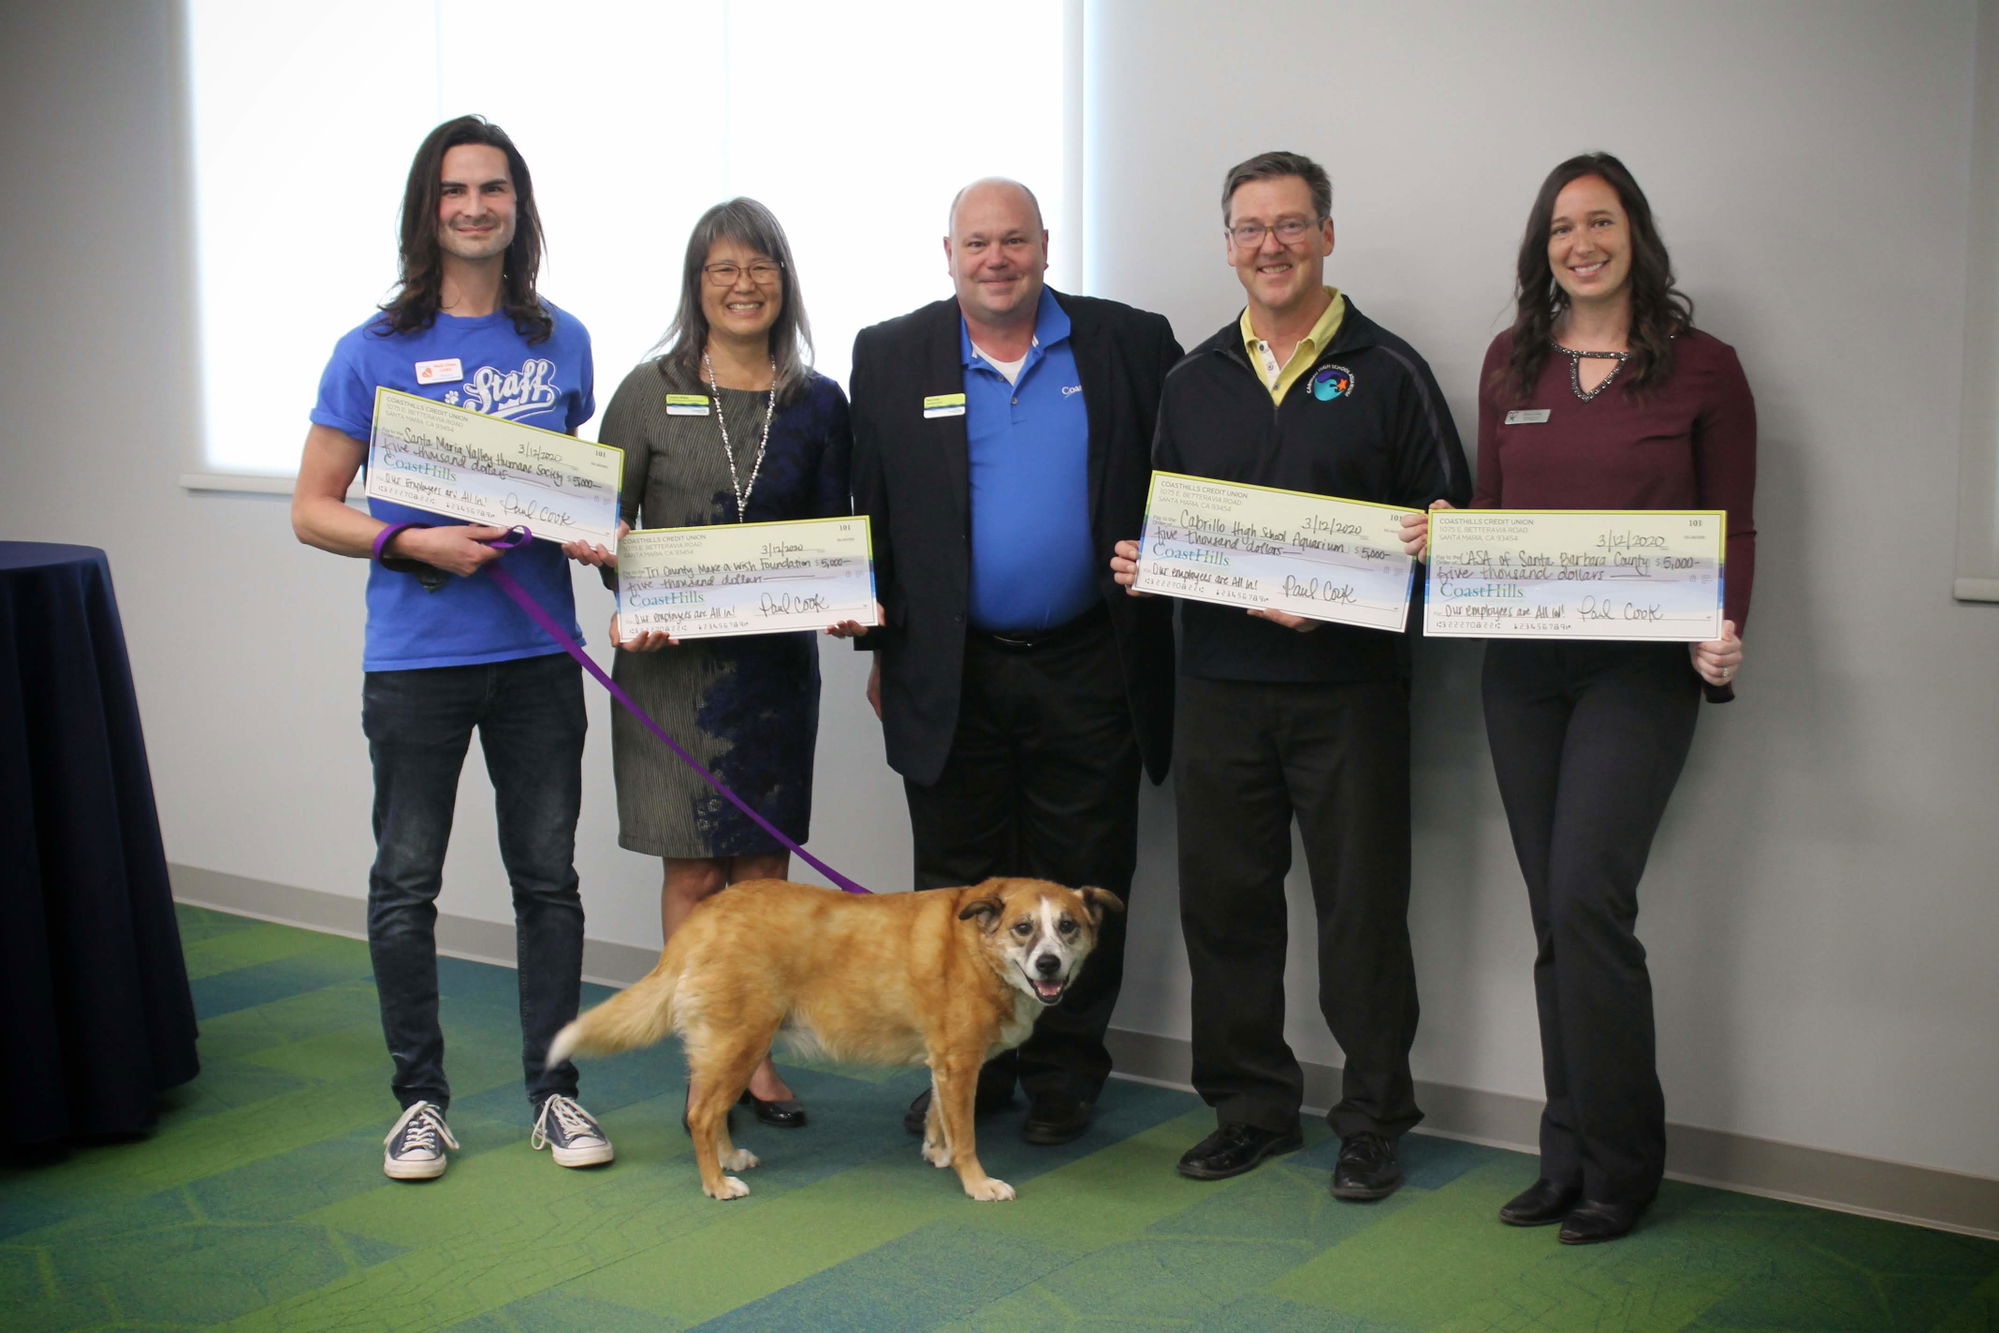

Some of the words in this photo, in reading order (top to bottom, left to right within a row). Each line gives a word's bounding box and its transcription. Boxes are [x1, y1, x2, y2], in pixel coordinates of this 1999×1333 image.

[463, 358, 557, 414] Staff
[403, 426, 432, 447] Santa
[436, 435, 463, 454] Maria
[464, 443, 495, 467] Valley
[497, 453, 533, 474] Humane
[413, 445, 467, 469] thousand
[518, 441, 562, 462] 3/12/2020
[383, 453, 457, 482] CoastHills
[385, 472, 400, 485] Our
[1160, 480, 1201, 492] COASTHILLS
[1202, 486, 1226, 496] CREDIT
[1226, 489, 1248, 499] UNION
[500, 491, 537, 520] Paul
[539, 506, 577, 527] Cook
[1180, 509, 1226, 533] Cabrillo
[1232, 520, 1257, 545] High
[1262, 526, 1287, 543] School
[1292, 532, 1344, 553] Aquarium
[1302, 515, 1362, 535] 3/12/2020
[1439, 517, 1483, 525] COASTHILLS
[1484, 518, 1511, 526] CREDIT
[1512, 518, 1534, 526] UNION
[1688, 519, 1703, 527] 101
[761, 540, 804, 557] 3/12/2020
[1153, 526, 1178, 546] five
[1186, 530, 1239, 550] thousand
[1245, 540, 1281, 556] dollars
[1596, 529, 1665, 553] 3/12/2020
[1152, 543, 1230, 567] CoastHills
[1498, 551, 1510, 567] of
[1519, 550, 1554, 567] Santa
[1559, 551, 1606, 567] Barbara
[1613, 551, 1651, 578] County
[644, 565, 659, 579] Tri
[663, 564, 694, 579] County
[697, 563, 721, 576] Make
[723, 563, 732, 573] a
[733, 560, 757, 572] Wish
[760, 557, 811, 571] Foundation
[1152, 562, 1169, 576] Our
[1171, 567, 1212, 584] employees
[1214, 576, 1229, 585] are
[1231, 576, 1244, 588] All
[1437, 565, 1475, 585] five
[1480, 566, 1553, 580] thousand
[1557, 566, 1605, 581] dollars
[627, 580, 652, 598] five
[659, 576, 715, 590] thousand
[1282, 574, 1318, 600] Paul
[1323, 580, 1357, 605] Cook
[1439, 582, 1524, 599] CoastHills
[629, 590, 704, 608] CoastHills
[759, 592, 791, 617] Paul
[793, 593, 830, 614] Cook
[1577, 594, 1616, 622] Paul
[1623, 601, 1664, 623] Cook
[634, 613, 649, 626] Our
[693, 610, 707, 619] are
[710, 606, 722, 618] All
[1445, 604, 1462, 618] Our
[1465, 604, 1513, 620] employees
[1516, 608, 1531, 617] are
[1534, 605, 1549, 619] All
